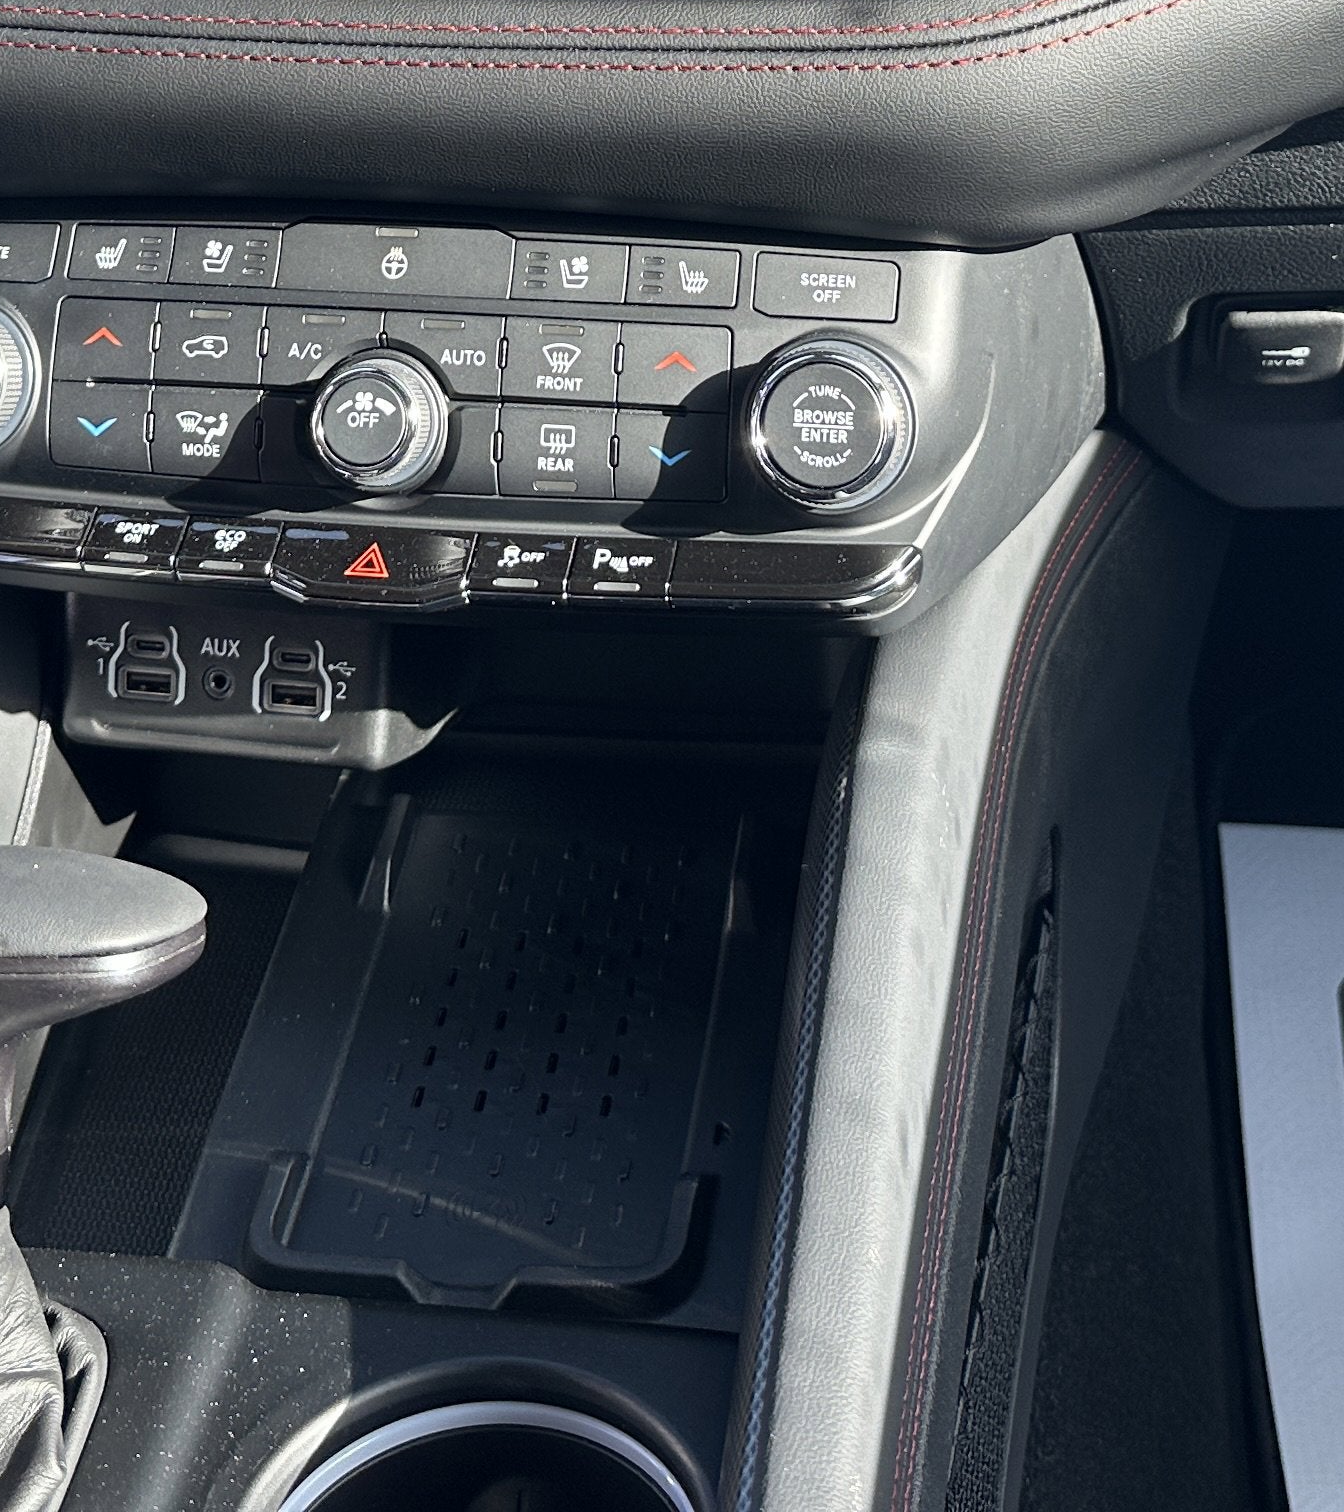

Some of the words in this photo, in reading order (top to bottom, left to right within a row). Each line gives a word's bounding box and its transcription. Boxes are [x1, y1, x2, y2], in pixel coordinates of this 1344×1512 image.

[800, 272, 856, 288] SCREEN
[812, 289, 842, 304] OFF
[288, 341, 323, 361] A/C
[440, 348, 486, 366] AUTO
[536, 375, 584, 392] FRONT
[808, 385, 843, 400] TUNE
[347, 412, 380, 428] OFF
[793, 409, 854, 426] BROWSE
[801, 428, 848, 444] ENTER
[181, 443, 221, 458] MODE
[537, 456, 574, 472] REAR
[799, 450, 846, 468] SCROLL
[115, 521, 160, 536] SPORT
[123, 533, 142, 544] ON
[214, 540, 239, 552] OFF
[521, 552, 546, 562] OFF
[592, 548, 612, 569] P
[629, 556, 654, 566] OFF
[200, 638, 241, 658] AUX
[96, 657, 104, 675] 1
[335, 681, 347, 700] 2
